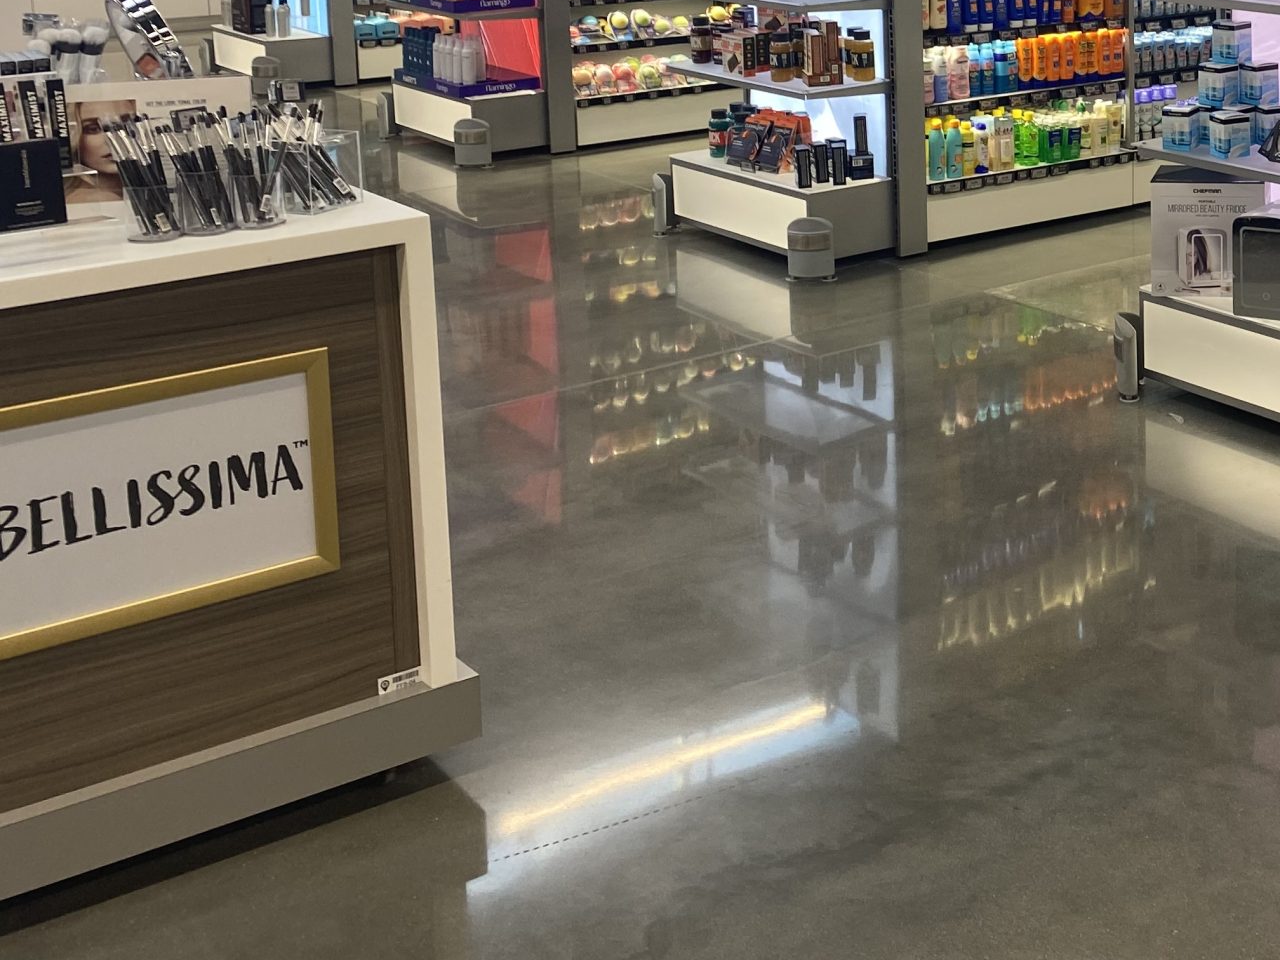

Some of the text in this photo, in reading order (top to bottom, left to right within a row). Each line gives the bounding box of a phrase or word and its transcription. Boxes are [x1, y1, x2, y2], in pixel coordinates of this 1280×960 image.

[485, 83, 516, 92] flamingo
[26, 90, 45, 138] MAXIMIST
[54, 90, 69, 138] MAXIMIST
[1167, 203, 1247, 214] MIRRORED BEAUTY FRIDGE
